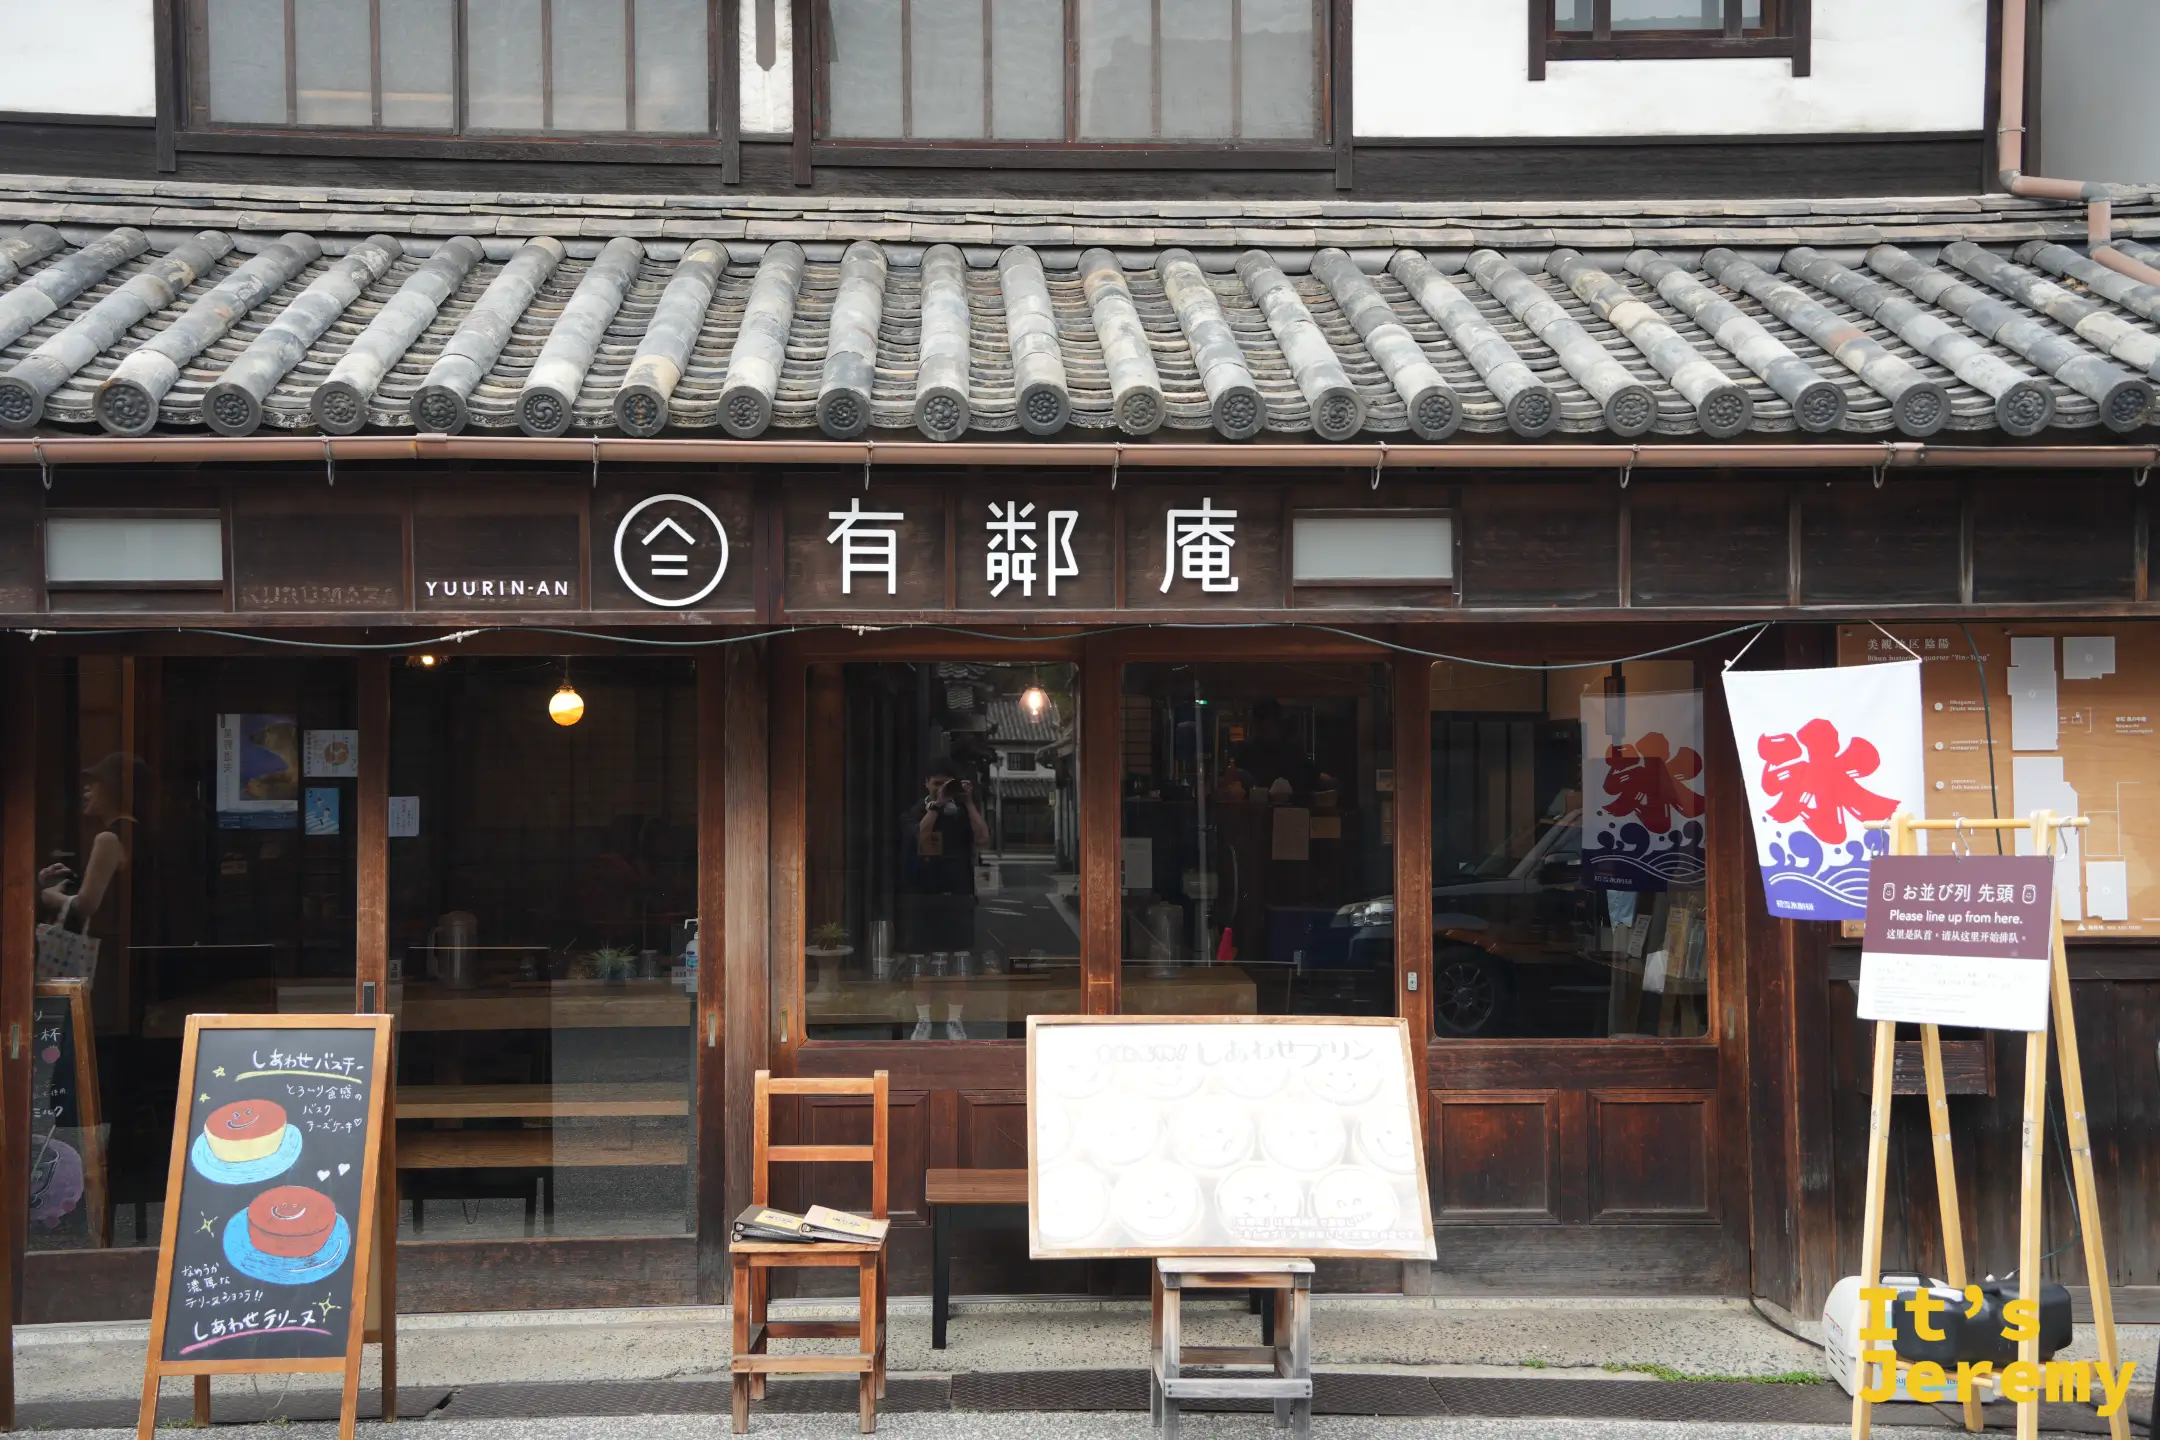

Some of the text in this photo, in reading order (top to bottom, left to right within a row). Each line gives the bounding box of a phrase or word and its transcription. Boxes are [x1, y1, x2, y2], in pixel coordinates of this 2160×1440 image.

[827, 497, 1240, 597] 有鄰庵
[425, 580, 570, 597] YUURIN-AN
[1923, 654, 1949, 662] quarter
[1757, 718, 1901, 845] 氷
[1903, 883, 2015, 903] お並び列 先頭
[1889, 909, 2023, 926] Please line up from here.
[252, 1048, 365, 1076] しあわせバスチー
[302, 1103, 332, 1116] バスク
[186, 1275, 231, 1293] 濃厚な
[194, 1308, 316, 1342] しあわせテリーヌ
